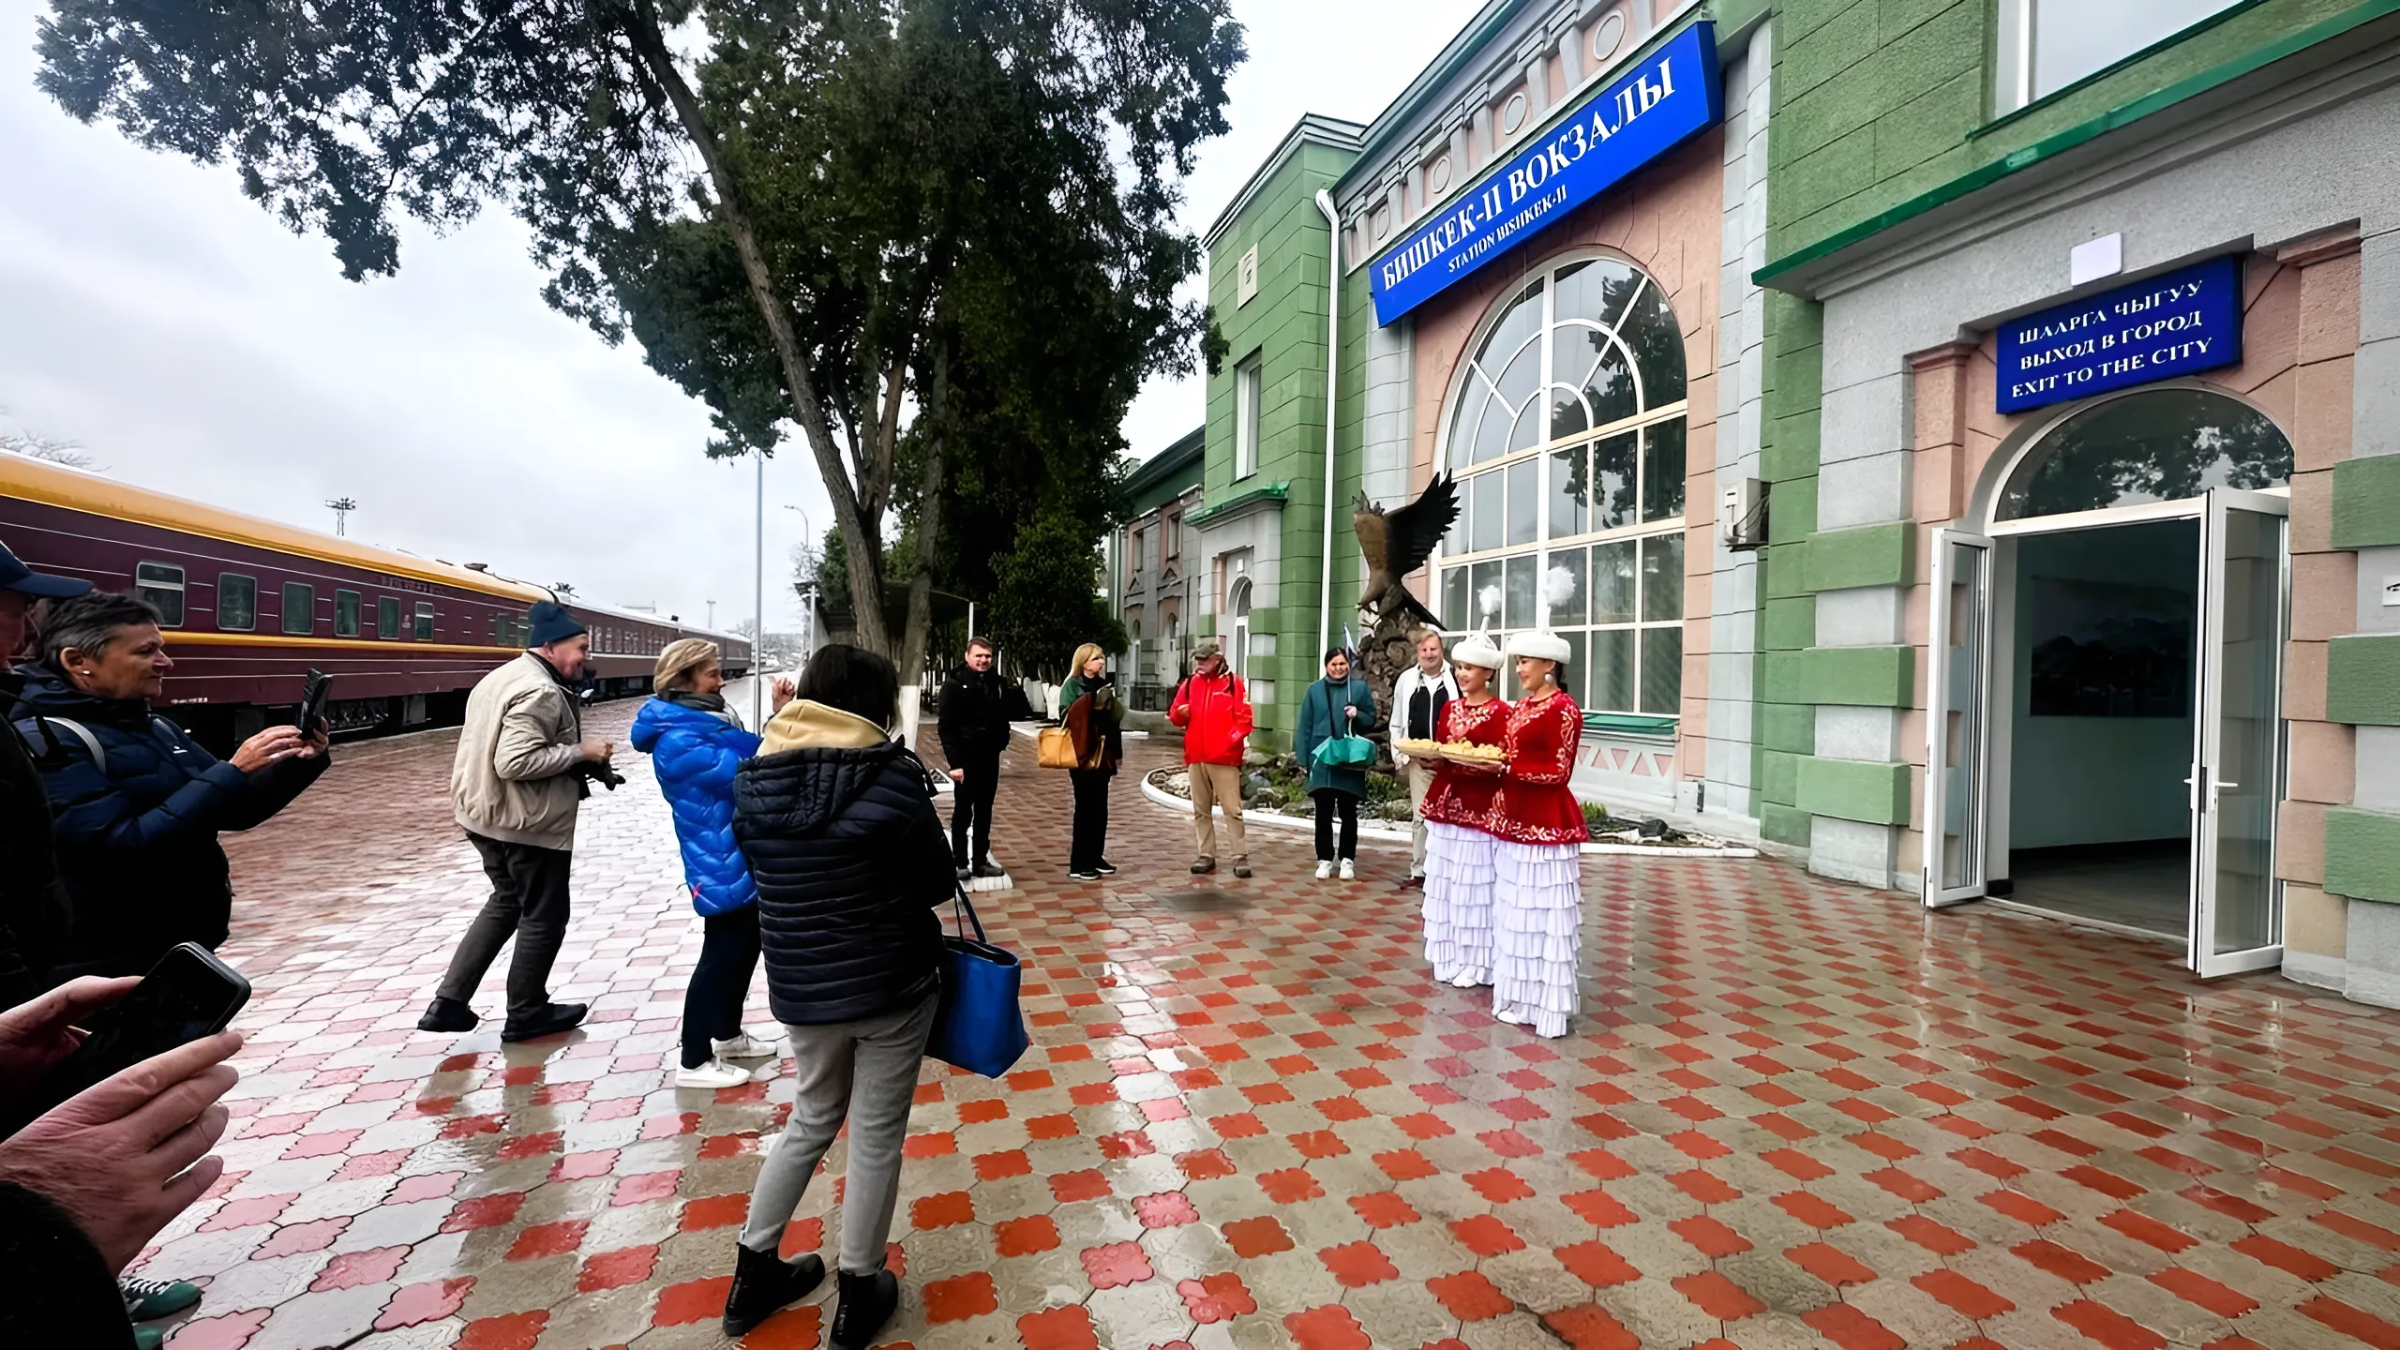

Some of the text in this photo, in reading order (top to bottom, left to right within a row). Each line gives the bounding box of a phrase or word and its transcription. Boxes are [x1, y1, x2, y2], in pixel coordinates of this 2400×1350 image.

[1507, 56, 1676, 205] ВОКЗАЛЫ
[1448, 232, 1496, 273] STATION
[2019, 280, 2202, 344] ШААРГА ЧЫГУУ
[2021, 311, 2202, 370] ВЫХОД В ГОРОД
[2012, 337, 2212, 398] EXIT TO THE CITY
